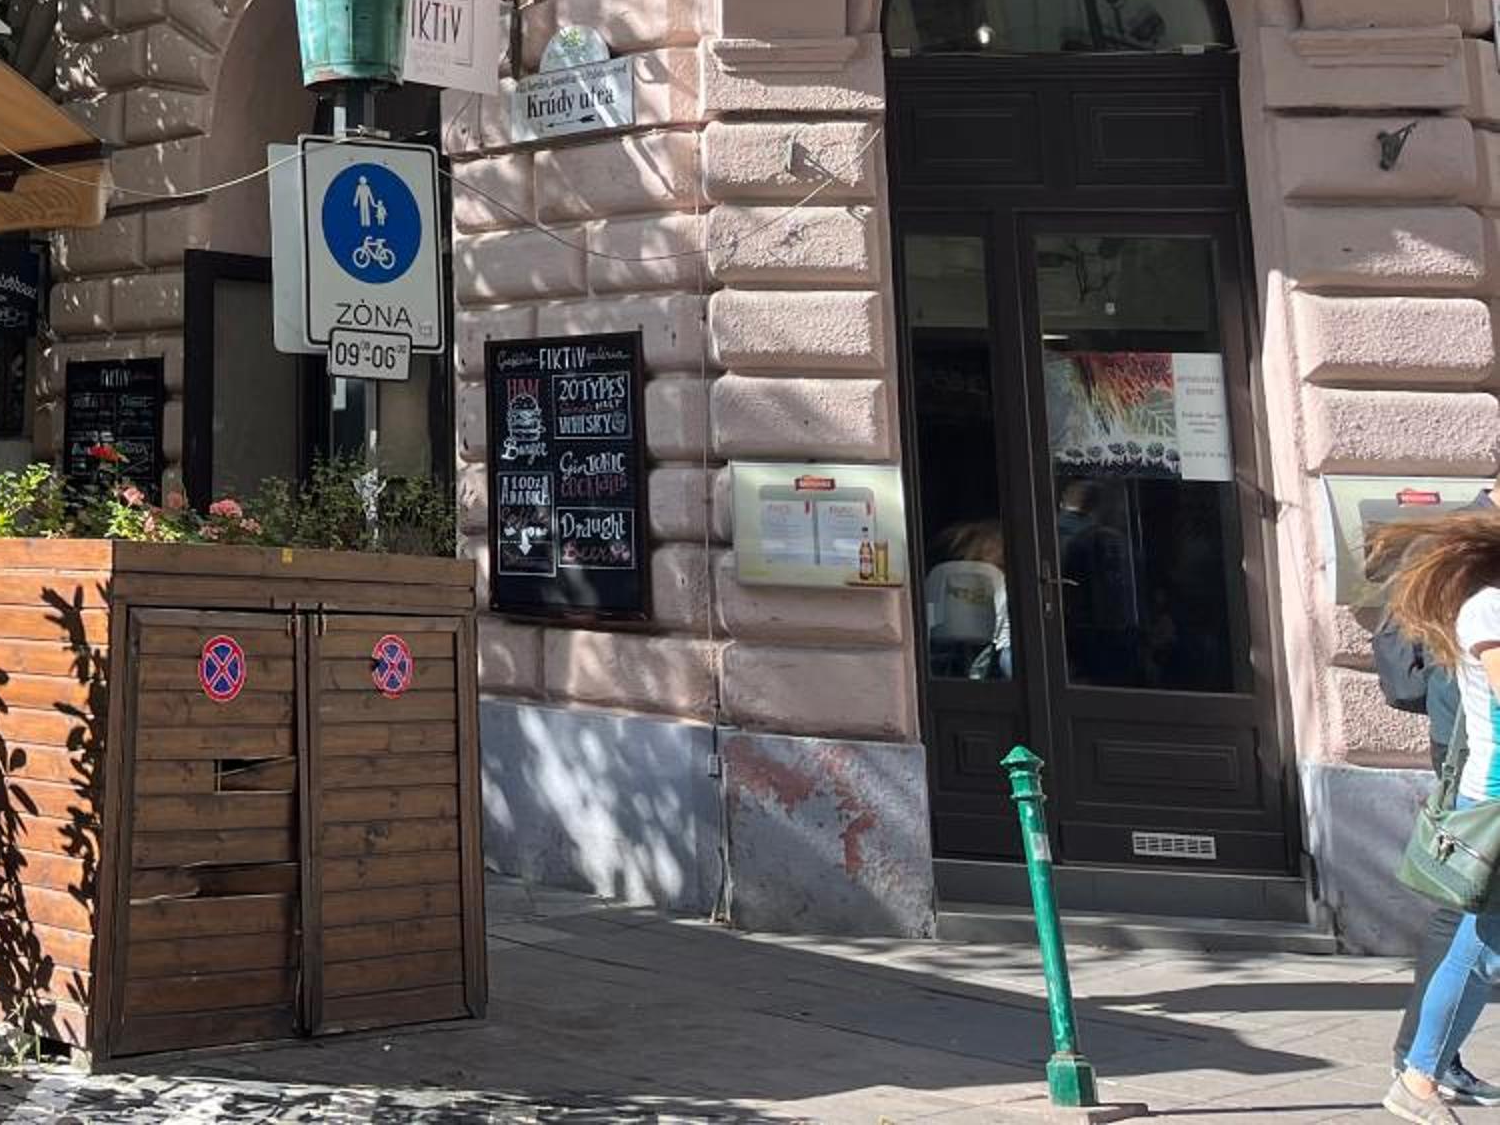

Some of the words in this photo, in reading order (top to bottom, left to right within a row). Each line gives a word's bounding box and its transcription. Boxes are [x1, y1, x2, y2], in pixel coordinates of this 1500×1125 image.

[527, 88, 575, 119] Krúdy
[580, 86, 614, 109] utca
[336, 299, 413, 328] ZÓNA
[561, 513, 627, 540] Draught
